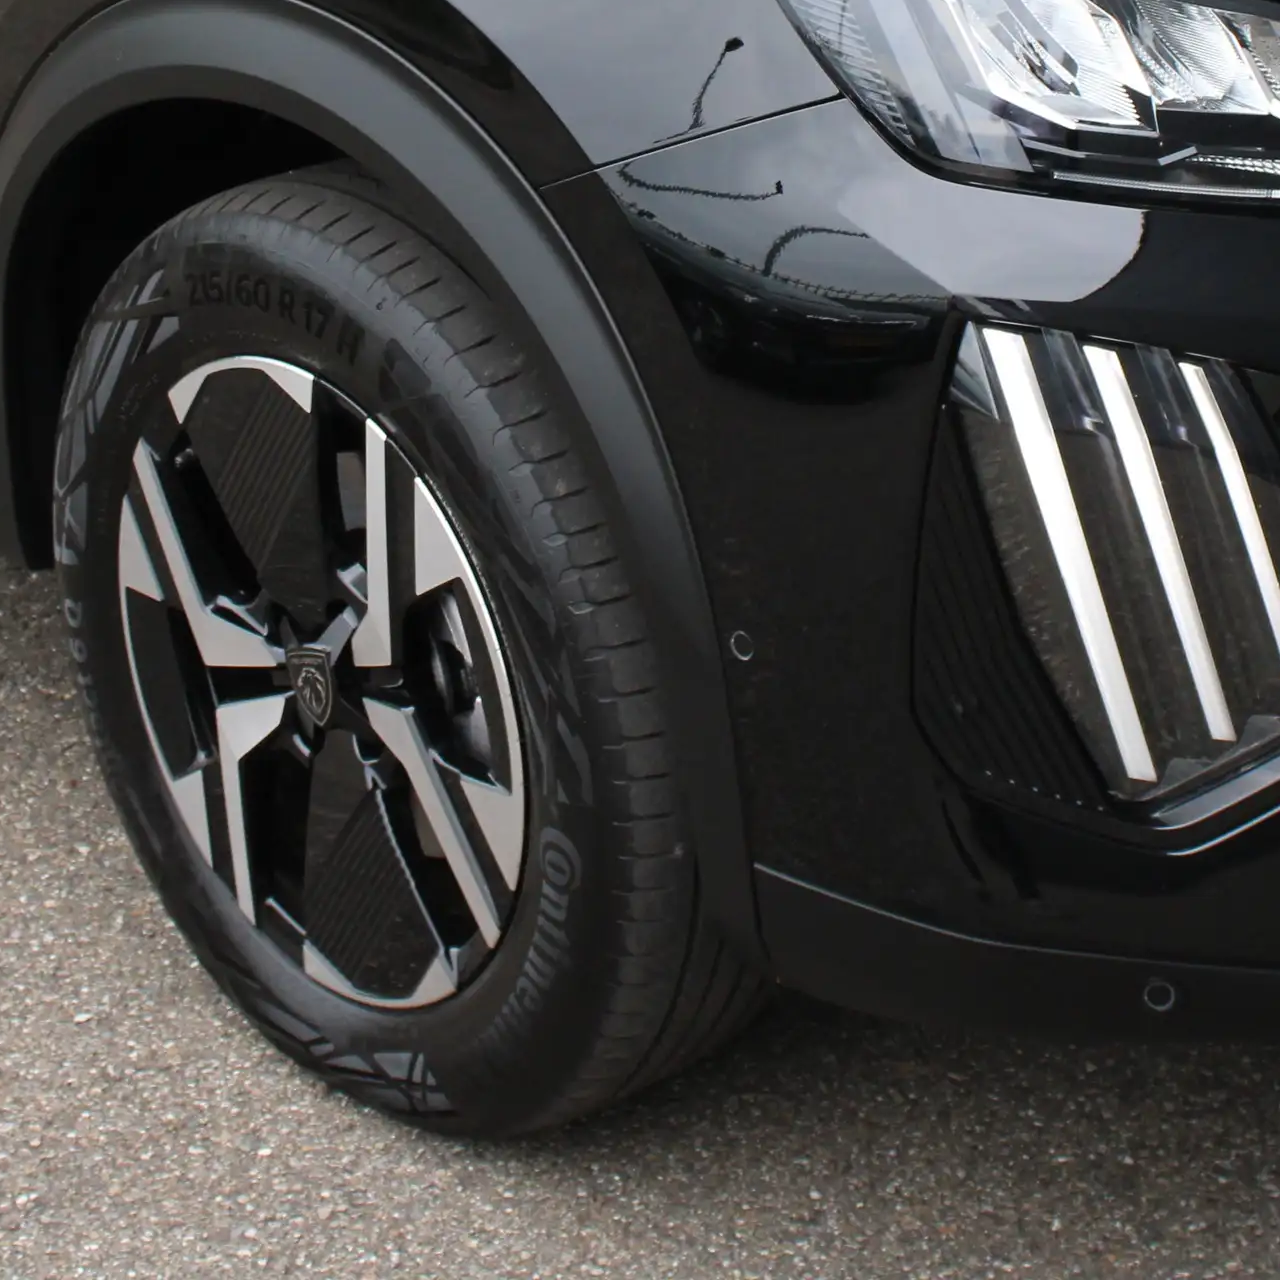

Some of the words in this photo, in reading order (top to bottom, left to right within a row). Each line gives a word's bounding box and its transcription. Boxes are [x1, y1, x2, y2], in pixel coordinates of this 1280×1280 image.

[186, 270, 270, 313] 215/60
[277, 287, 296, 325] R
[302, 294, 334, 340] 17
[468, 825, 583, 1062] Continen
